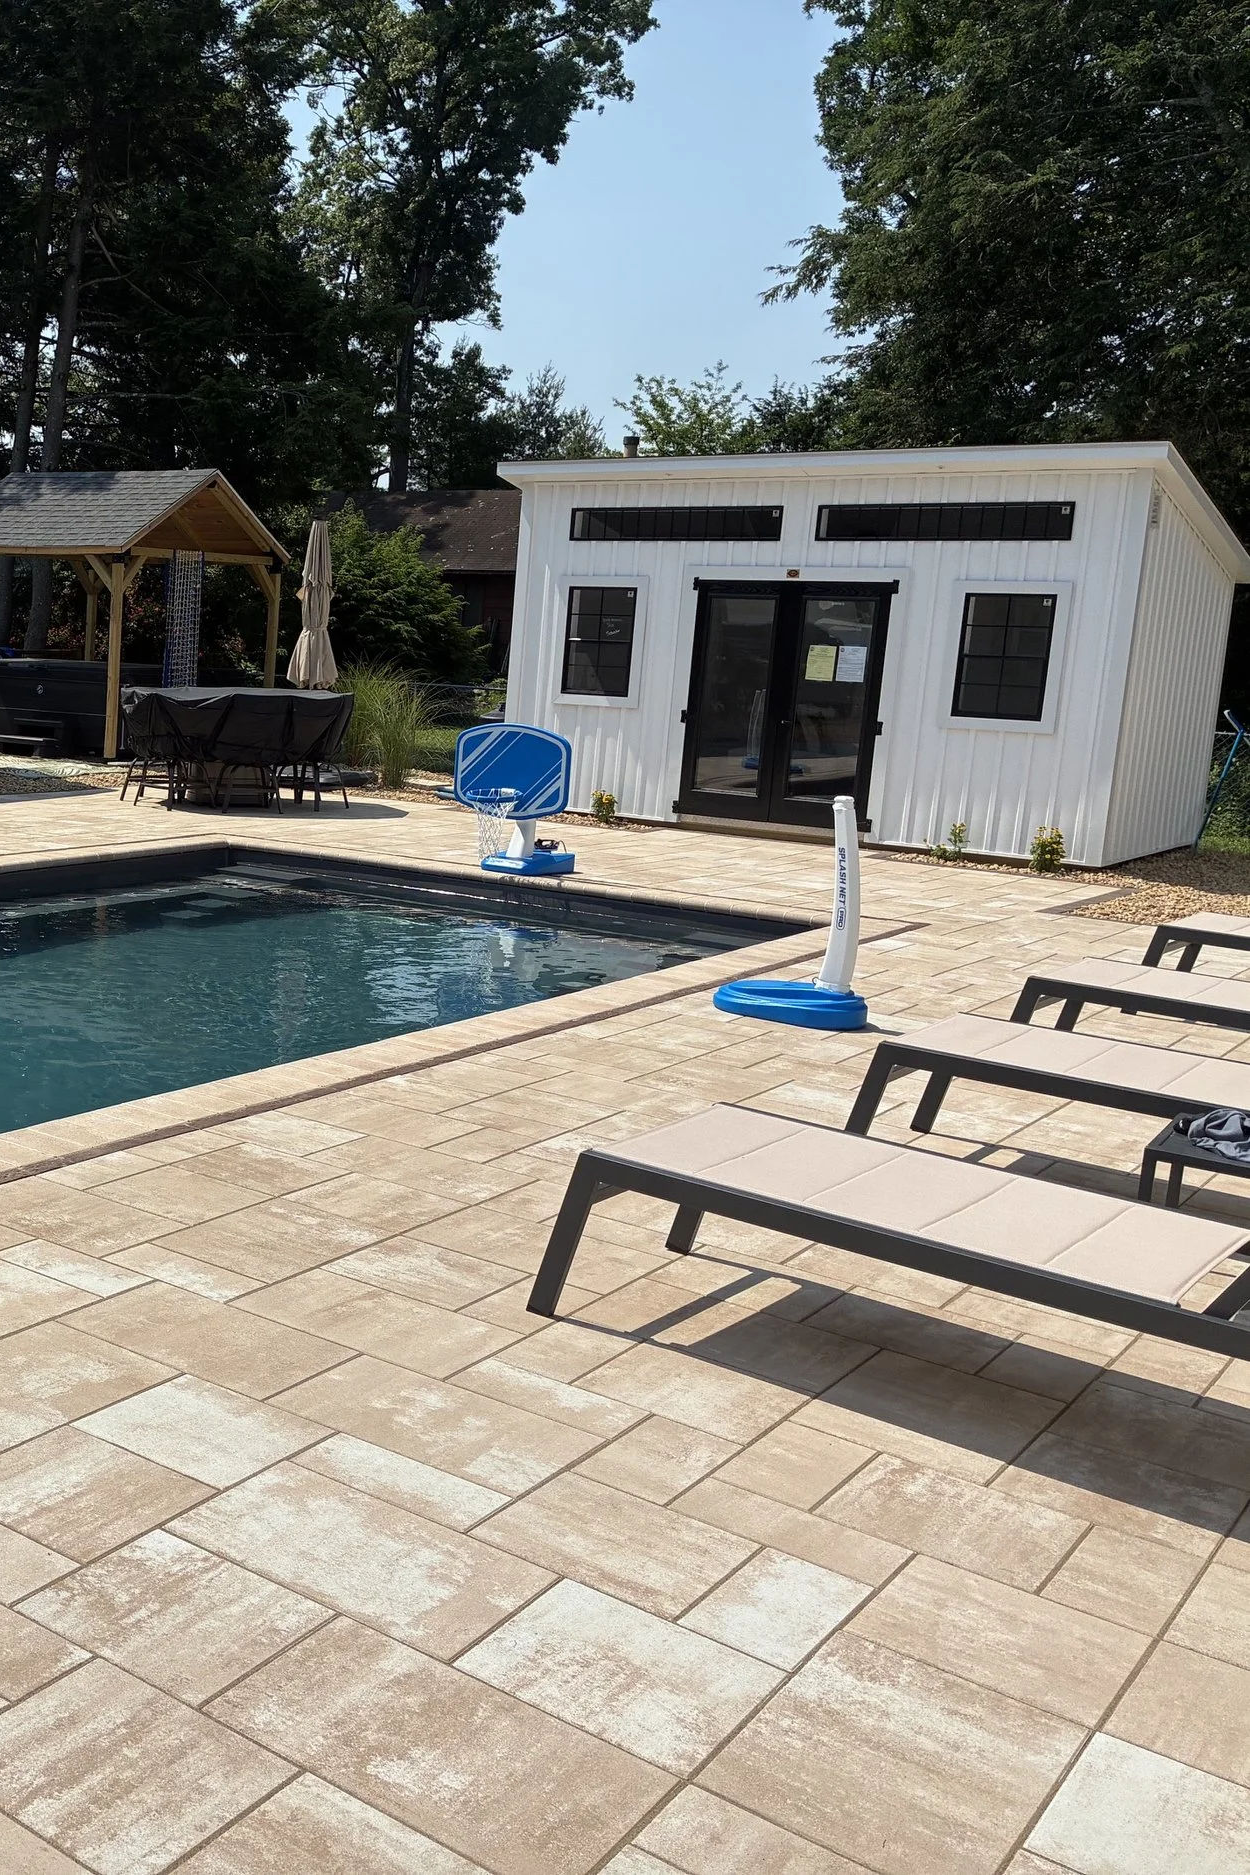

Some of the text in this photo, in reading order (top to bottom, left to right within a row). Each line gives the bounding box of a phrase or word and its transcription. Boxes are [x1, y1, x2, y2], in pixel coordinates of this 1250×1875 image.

[837, 847, 846, 928] SPLASH NET PRO
